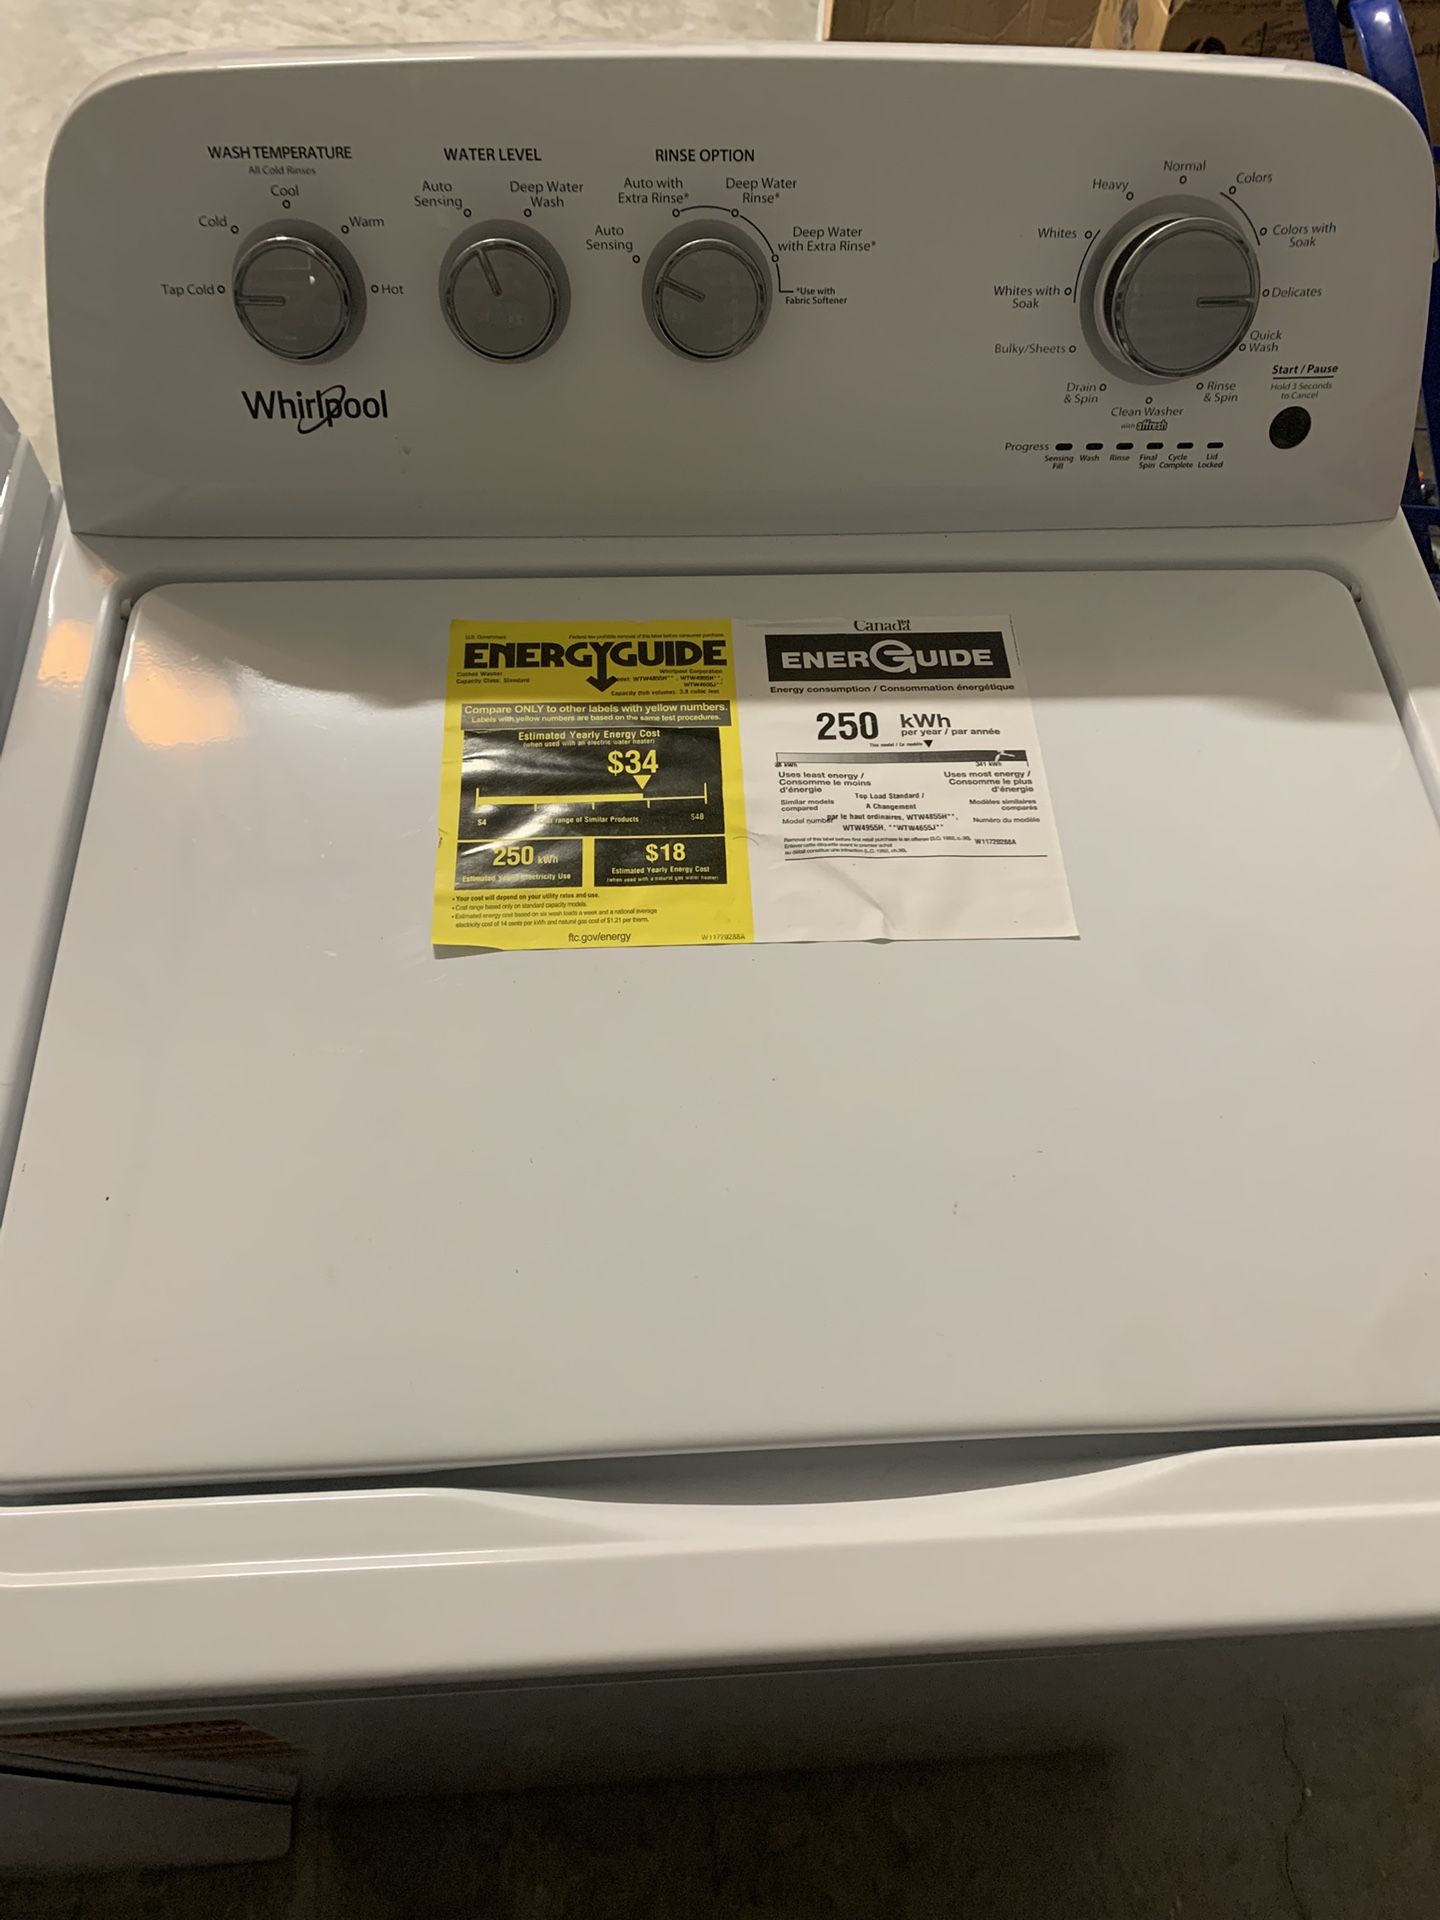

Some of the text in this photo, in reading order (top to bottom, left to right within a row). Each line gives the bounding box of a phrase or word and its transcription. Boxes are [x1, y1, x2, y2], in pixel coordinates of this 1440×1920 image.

[207, 145, 352, 160] WASH TEMPERATURE
[443, 147, 543, 161] WATER LEVEL
[655, 148, 755, 162] RINSE OPTION
[249, 165, 316, 175] All Cold Rinses
[1163, 160, 1206, 172] Normal
[623, 176, 684, 189] Auto with
[1236, 171, 1273, 184] Colors
[422, 180, 453, 192] Auto
[509, 180, 584, 194] Deep Water
[725, 177, 798, 191] Deep Water
[1092, 178, 1129, 193] Heavy
[270, 184, 299, 197] Cool
[413, 195, 463, 210] Sensing
[530, 195, 565, 208] Wash
[617, 192, 649, 204] Extra
[198, 215, 228, 228] Cold
[348, 215, 385, 228] Warm
[594, 224, 625, 237] Auto
[792, 226, 864, 239] Deep Water
[1037, 227, 1077, 239] Whites
[1272, 221, 1337, 236] Colors with
[585, 238, 634, 253] Sensing
[777, 240, 804, 251] with
[806, 241, 837, 251] Extra
[1288, 236, 1317, 248] Soak
[160, 283, 215, 297] Tap Cold
[381, 283, 404, 295] Hot
[817, 287, 836, 296] with
[993, 285, 1060, 296] Whites with
[1271, 286, 1323, 298] Delicates
[785, 296, 848, 305] Fabric Softener
[1011, 297, 1040, 309] Soak
[1249, 330, 1282, 341] Quick
[994, 343, 1066, 356] Bulky/Sheets
[1248, 342, 1279, 353] Wash
[1272, 364, 1339, 375] Start Pause
[1066, 382, 1097, 393] Drain
[1206, 381, 1237, 391] Rinse
[1270, 381, 1333, 391] Hold Seconds
[1063, 394, 1099, 405] & Spin
[1202, 392, 1239, 404] & Spin
[1281, 391, 1319, 400] to Cancel
[241, 387, 388, 431] Whirlpool
[1110, 406, 1184, 417] Clean Washer
[1004, 442, 1050, 454] Progress
[1044, 454, 1074, 464] Sensing
[1079, 454, 1101, 462] Wash
[1109, 454, 1131, 462] Rinse
[1139, 453, 1158, 461] Final
[1167, 453, 1188, 462] Cycle
[1206, 453, 1219, 461] Lid
[1051, 462, 1065, 471] Fill
[1138, 461, 1156, 470] Spin
[1158, 461, 1194, 470] Complete
[1197, 460, 1224, 469] Locked
[854, 619, 911, 631] Canada
[464, 640, 727, 677] ENERGYGUIDE
[770, 683, 1015, 694] Energy consumption Consommation énergétique
[464, 702, 729, 715] Compare ONLY to other labels with yellow numbers.
[498, 715, 514, 723] with
[515, 715, 540, 724] yellow
[541, 714, 575, 722] numbers
[590, 714, 614, 722] based
[661, 713, 676, 721] test
[815, 711, 951, 741] 250 kWh
[518, 729, 661, 741] Estimated Yearly Energy Cost
[901, 727, 1001, 737] per year par année
[607, 749, 659, 777] $34
[778, 771, 858, 780] Uses least energy
[994, 771, 1025, 779] energy
[843, 779, 871, 787] moins
[949, 778, 1033, 786] Consomme plus
[779, 786, 822, 794] d'énergie
[991, 785, 1034, 794] d'énergie
[888, 792, 920, 800] Standard
[872, 803, 917, 811] Changement
[554, 816, 574, 825] range
[584, 815, 608, 823] Similar
[609, 815, 640, 823] Products
[492, 845, 559, 866] 250 kWh
[645, 842, 686, 863] $18
[557, 872, 572, 880] Use
[611, 865, 710, 876] Estimated Yearly Energy Cost
[568, 932, 631, 943] ftc.gov/energy
